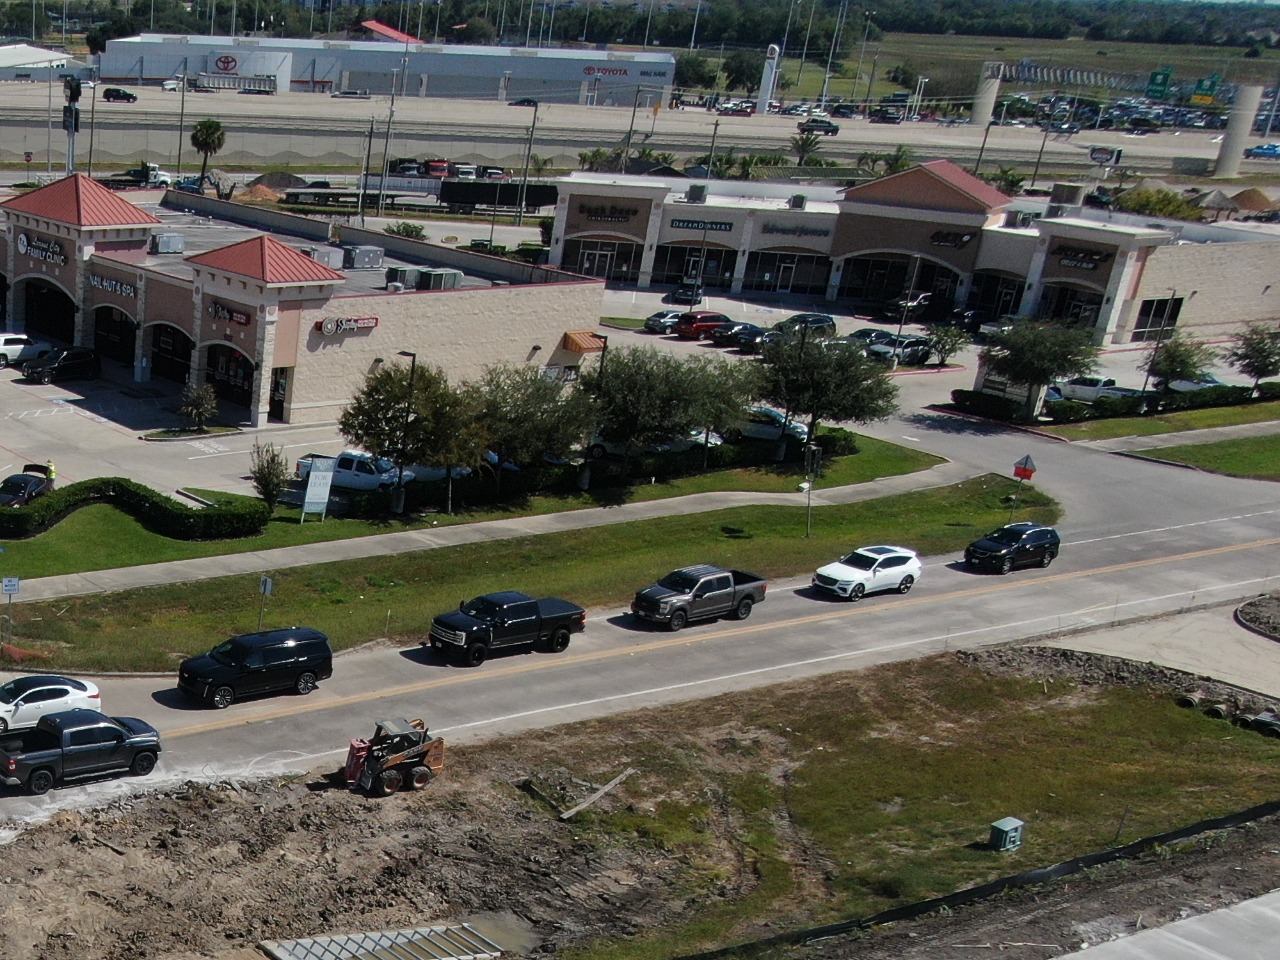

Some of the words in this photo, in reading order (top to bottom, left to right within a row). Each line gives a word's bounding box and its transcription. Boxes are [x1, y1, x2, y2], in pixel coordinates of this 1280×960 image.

[596, 67, 628, 76] TOYOTA
[46, 252, 65, 266] CLINIC
[90, 275, 102, 289] NAIL
[102, 278, 116, 292] HUT
[122, 284, 135, 299] SPA
